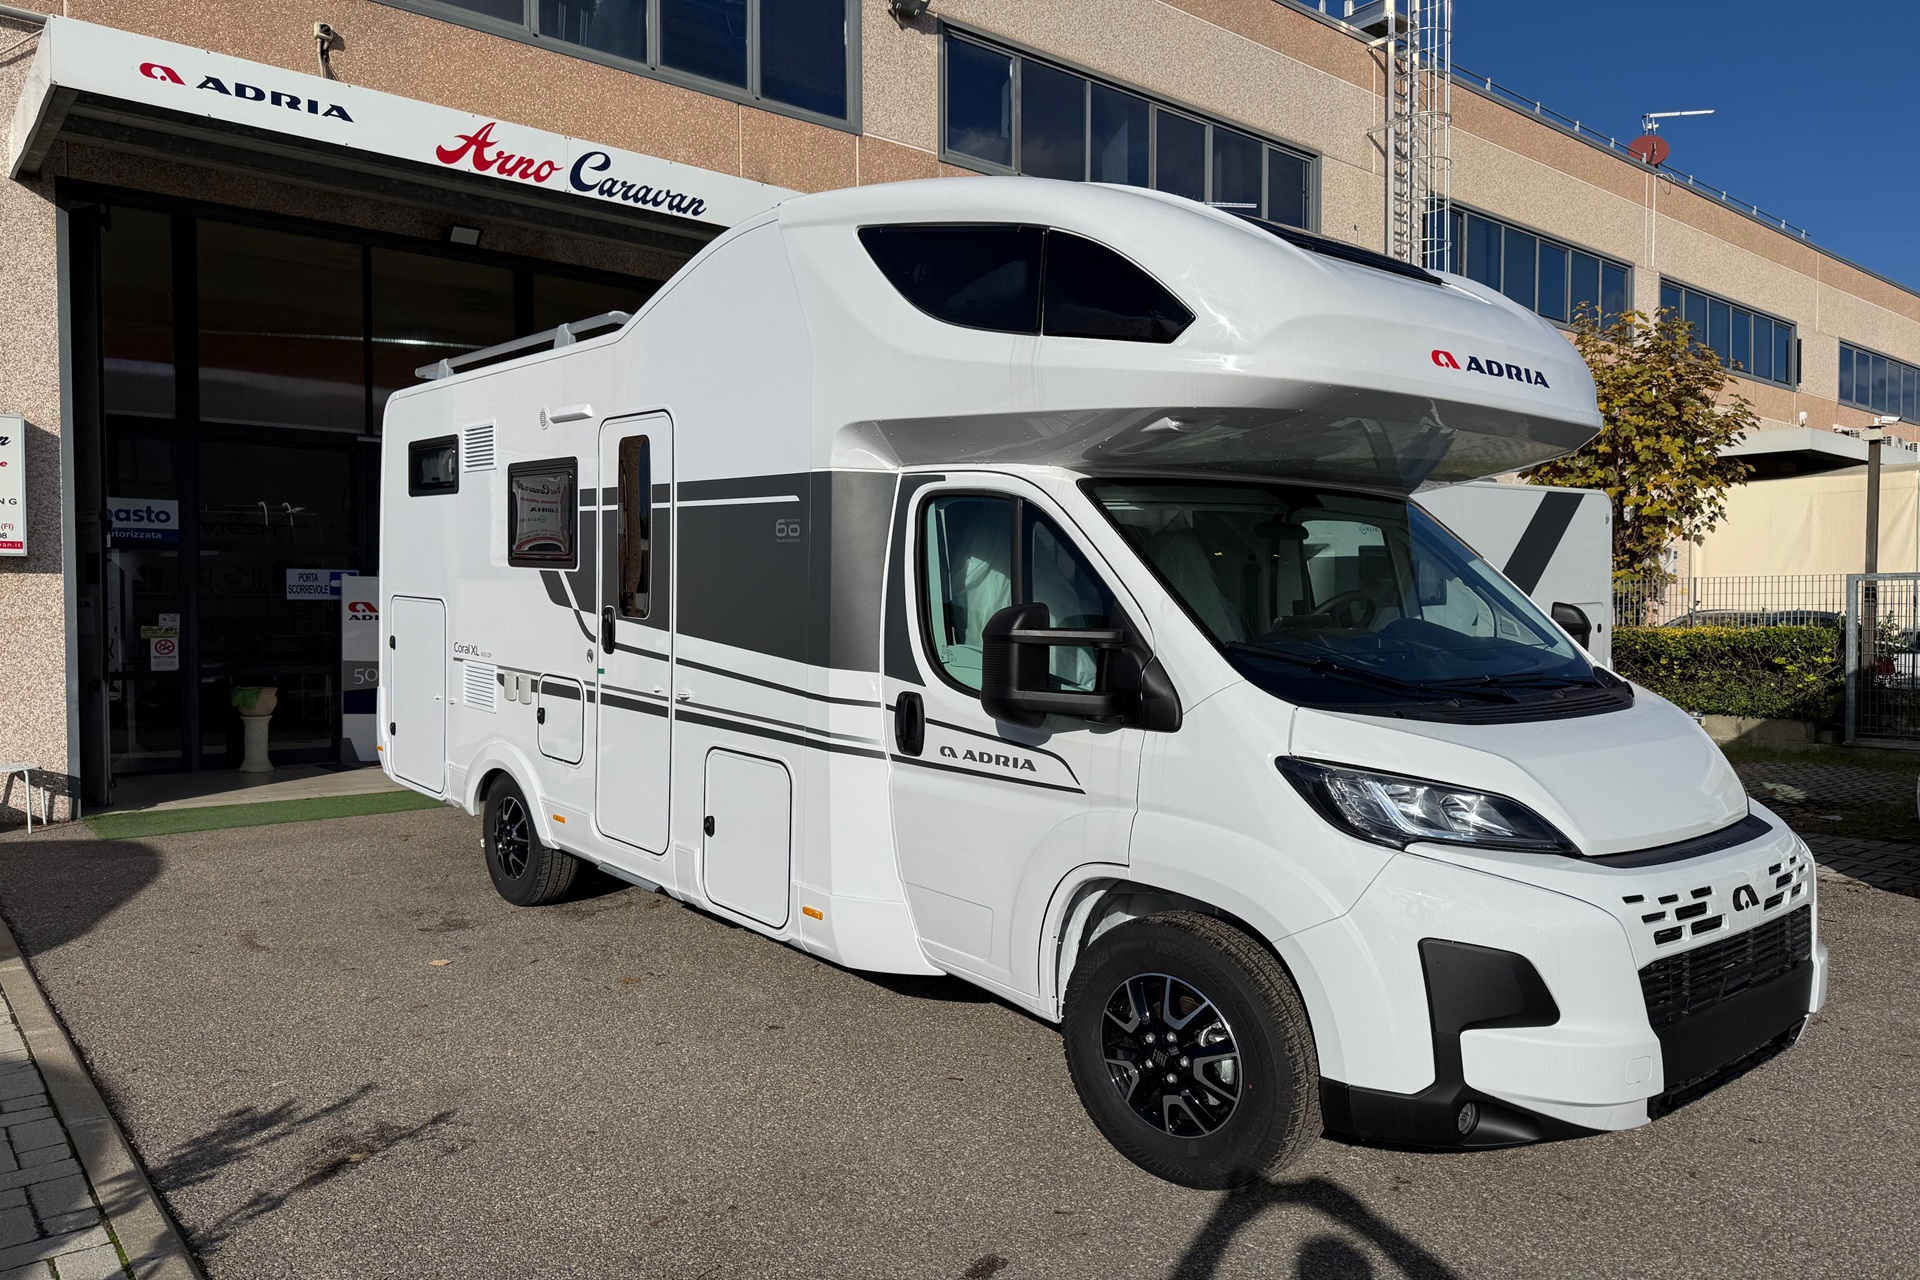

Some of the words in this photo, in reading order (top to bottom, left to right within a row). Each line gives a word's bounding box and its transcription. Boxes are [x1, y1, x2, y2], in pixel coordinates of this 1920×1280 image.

[196, 75, 355, 123] ADRIA
[435, 121, 565, 183] Arno
[569, 150, 708, 217] Caravan
[1466, 355, 1550, 389] ADRIA
[298, 572, 319, 582] PORTA
[288, 584, 329, 595] SCORREVOLE
[453, 641, 471, 655] Coral
[471, 644, 480, 657] XL
[352, 667, 379, 685] 50
[962, 749, 1037, 772] ADRIA
[1151, 1048, 1169, 1067] FIAT
